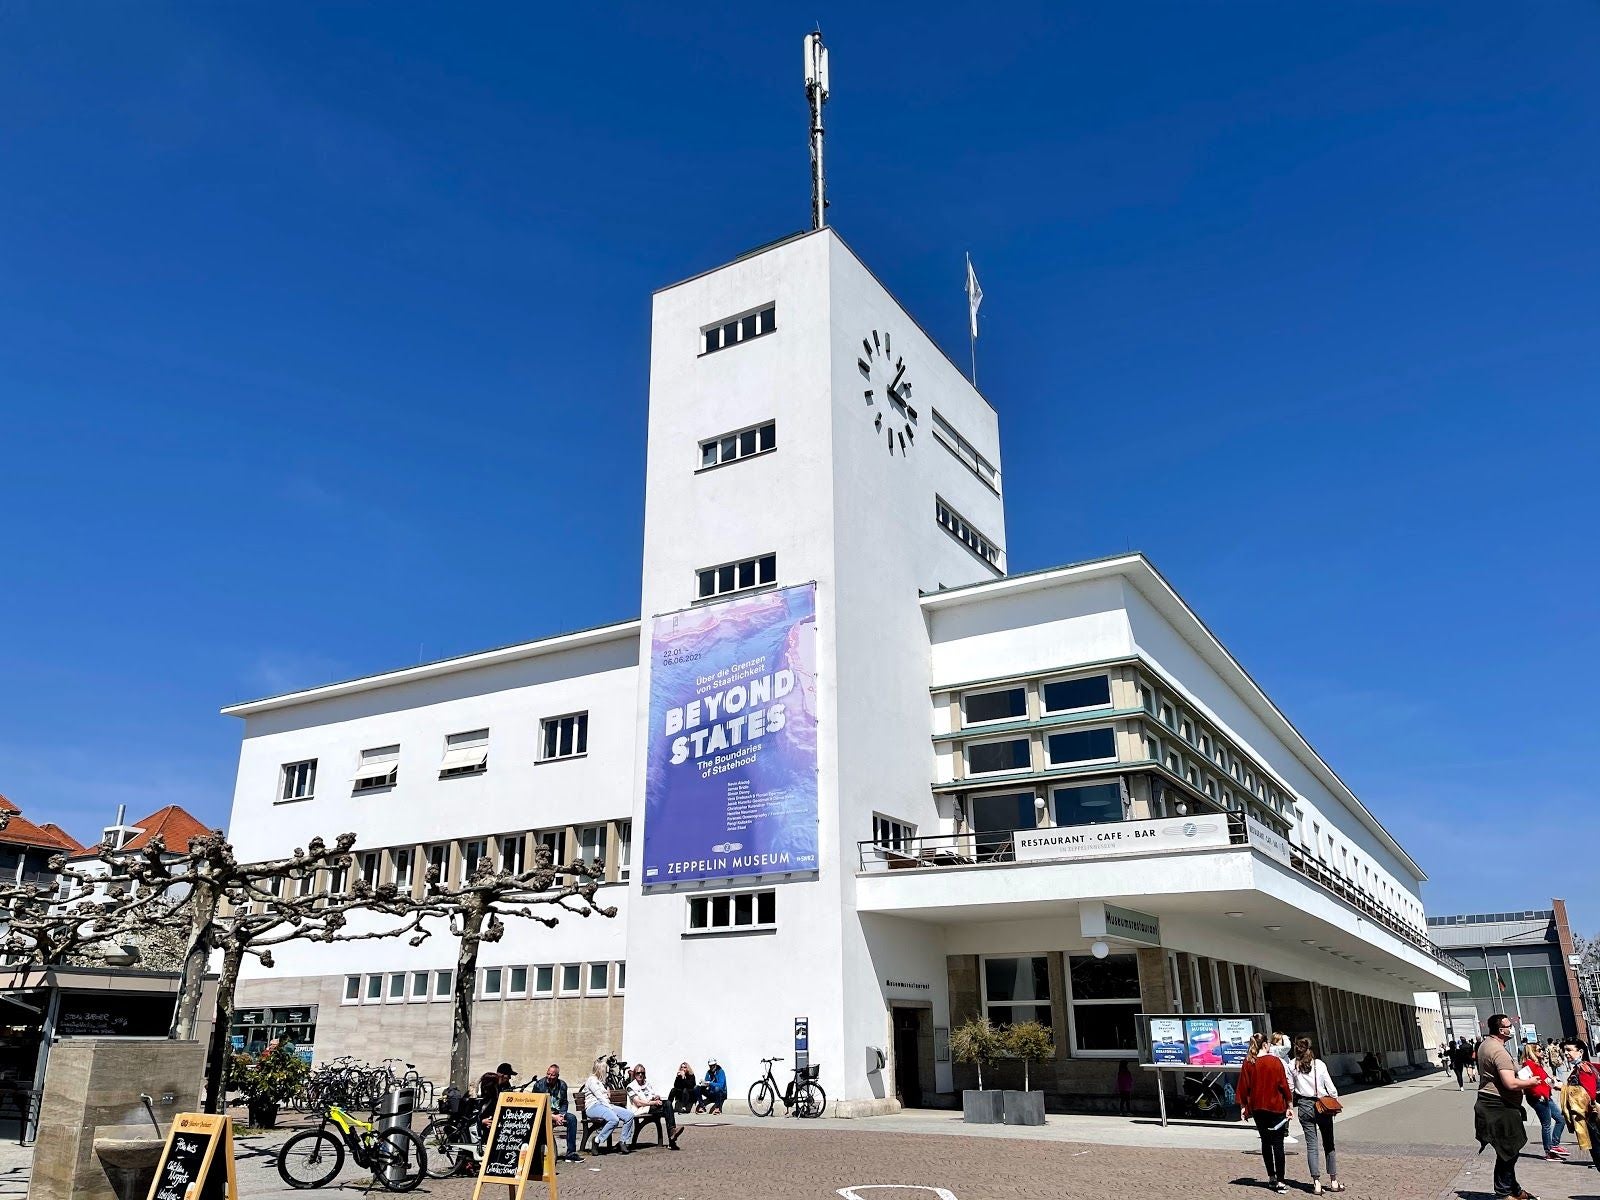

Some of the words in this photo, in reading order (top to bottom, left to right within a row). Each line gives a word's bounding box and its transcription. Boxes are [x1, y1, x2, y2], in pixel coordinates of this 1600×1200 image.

[663, 653, 702, 667] 06.06.2021
[696, 673, 716, 686] Über
[717, 665, 730, 677] die
[731, 655, 766, 673] Grenzen
[696, 684, 712, 695] von
[713, 665, 766, 689] Staatlichkeit
[665, 669, 795, 737] BEYOND
[669, 703, 787, 765] STATES
[697, 759, 713, 771] The
[714, 743, 763, 767] Boundaries
[702, 768, 712, 779] of
[712, 755, 757, 776] Statehood
[1021, 835, 1085, 848] RESTAURANT
[1097, 831, 1122, 842] CAFE
[1135, 828, 1156, 838] BAR
[667, 858, 727, 874] ZEPPELIN
[733, 852, 790, 868] MUSEUM
